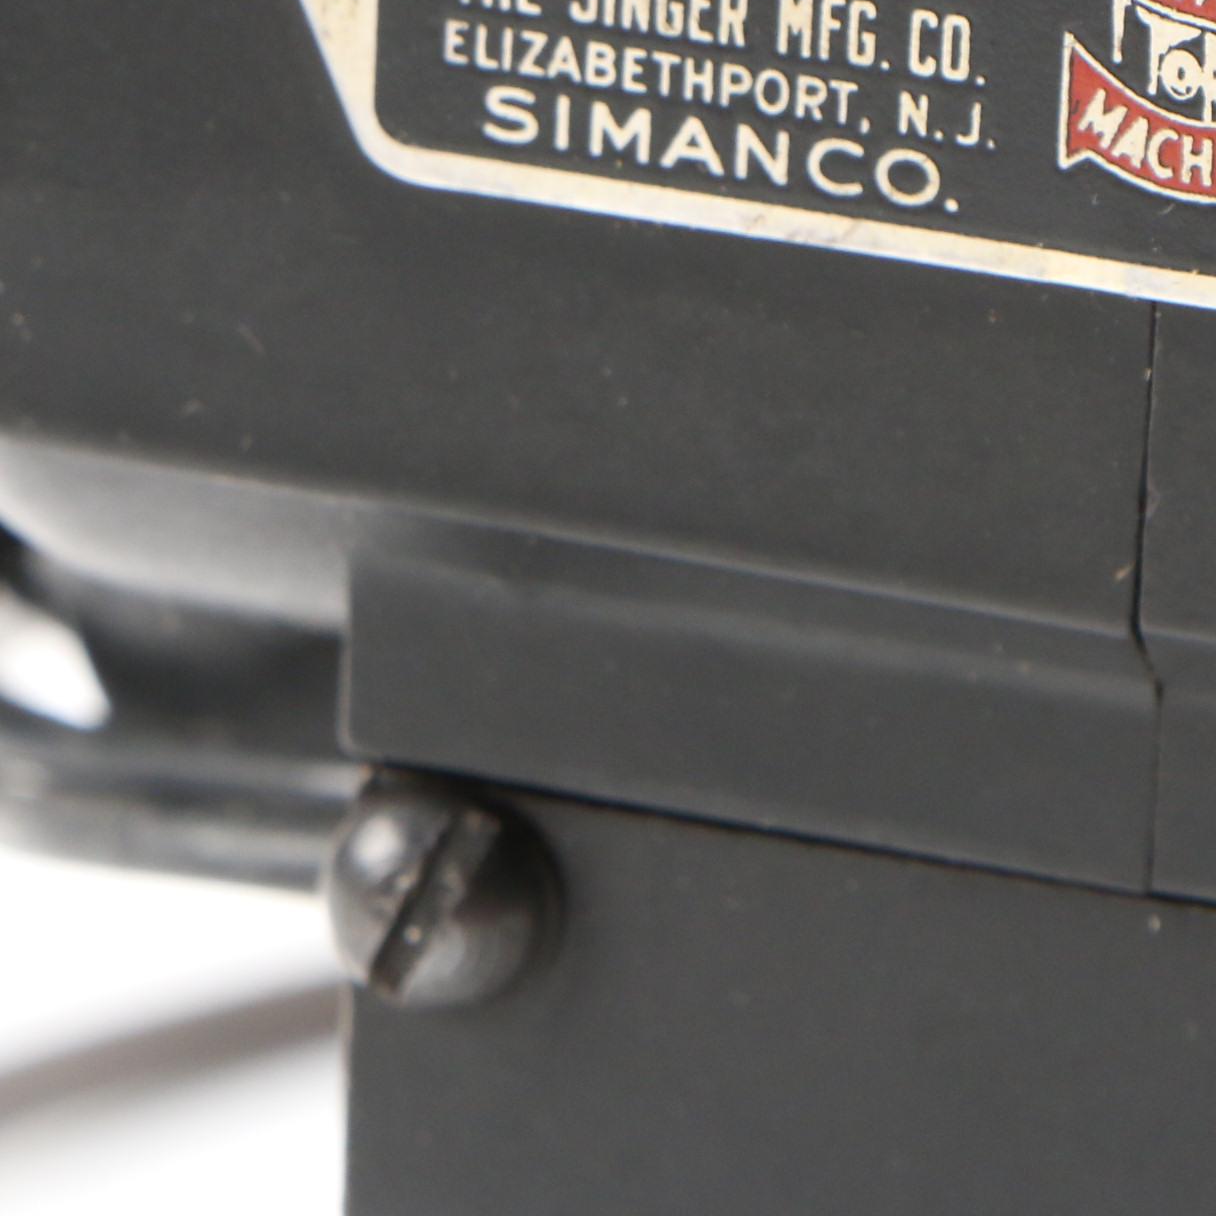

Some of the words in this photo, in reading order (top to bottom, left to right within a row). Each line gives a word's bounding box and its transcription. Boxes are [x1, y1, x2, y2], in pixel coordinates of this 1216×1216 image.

[444, 20, 869, 133] ELIZABETHPORT,
[908, 10, 985, 85] CO.
[483, 86, 958, 212] SIMANCO.
